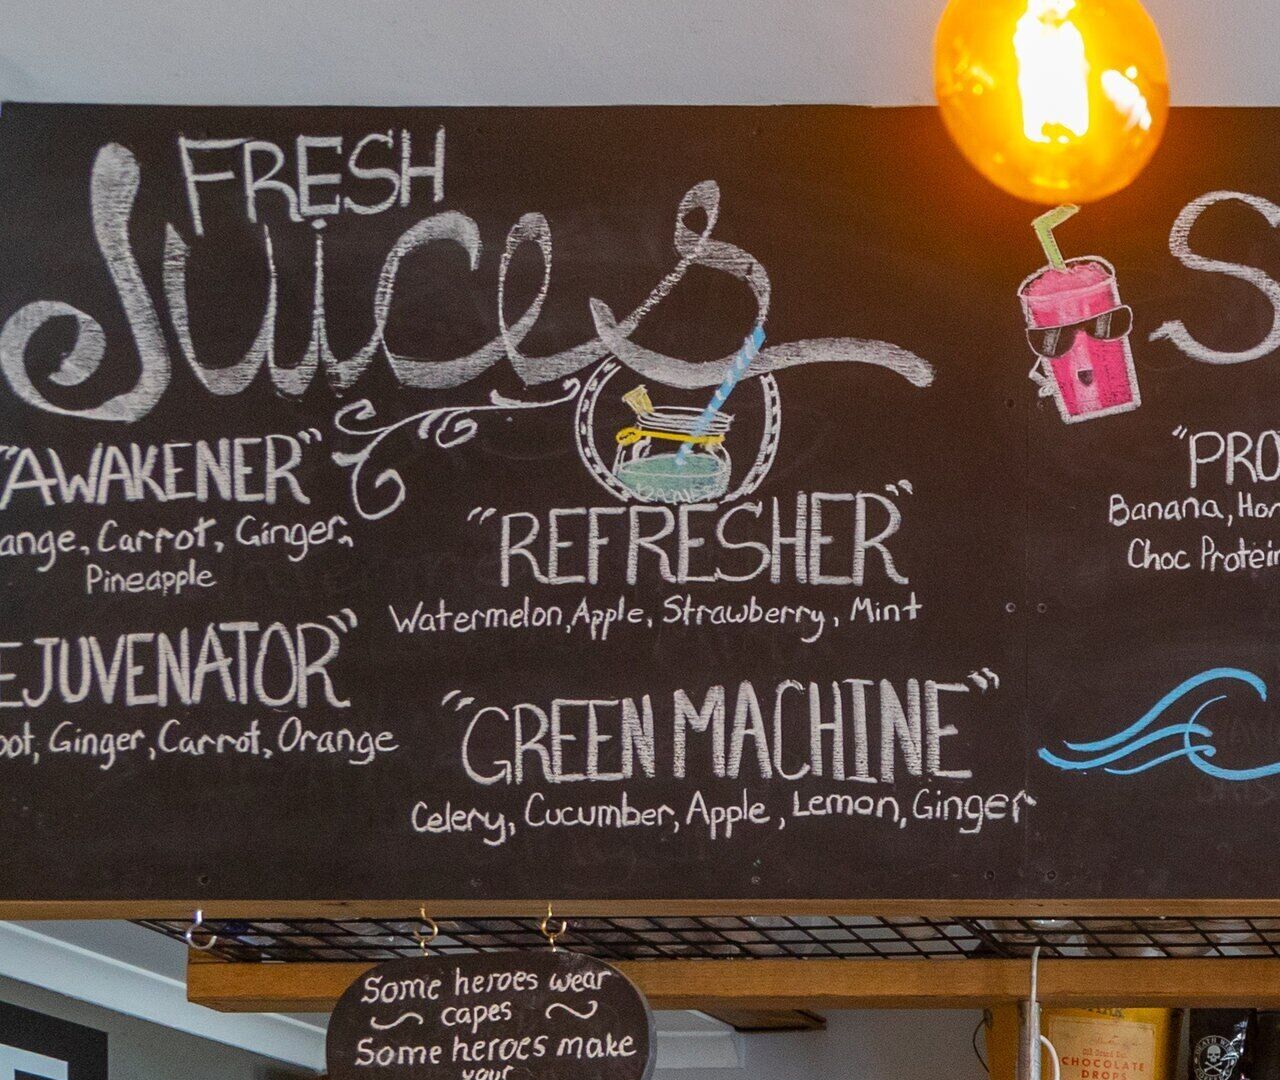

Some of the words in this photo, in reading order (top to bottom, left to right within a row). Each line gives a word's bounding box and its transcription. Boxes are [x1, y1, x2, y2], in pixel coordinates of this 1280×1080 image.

[180, 127, 445, 235] FRESH
[0, 144, 932, 421] Juices
[361, 976, 441, 1003] Some
[455, 968, 538, 995] heroes
[549, 970, 612, 992] wear
[441, 1001, 511, 1033] capes
[355, 1037, 442, 1066] Some
[452, 1035, 548, 1061] heroes
[557, 1033, 636, 1059] make
[1061, 1056, 1145, 1071] CHOCOLATE
[1081, 1070, 1127, 1080] DROPS
